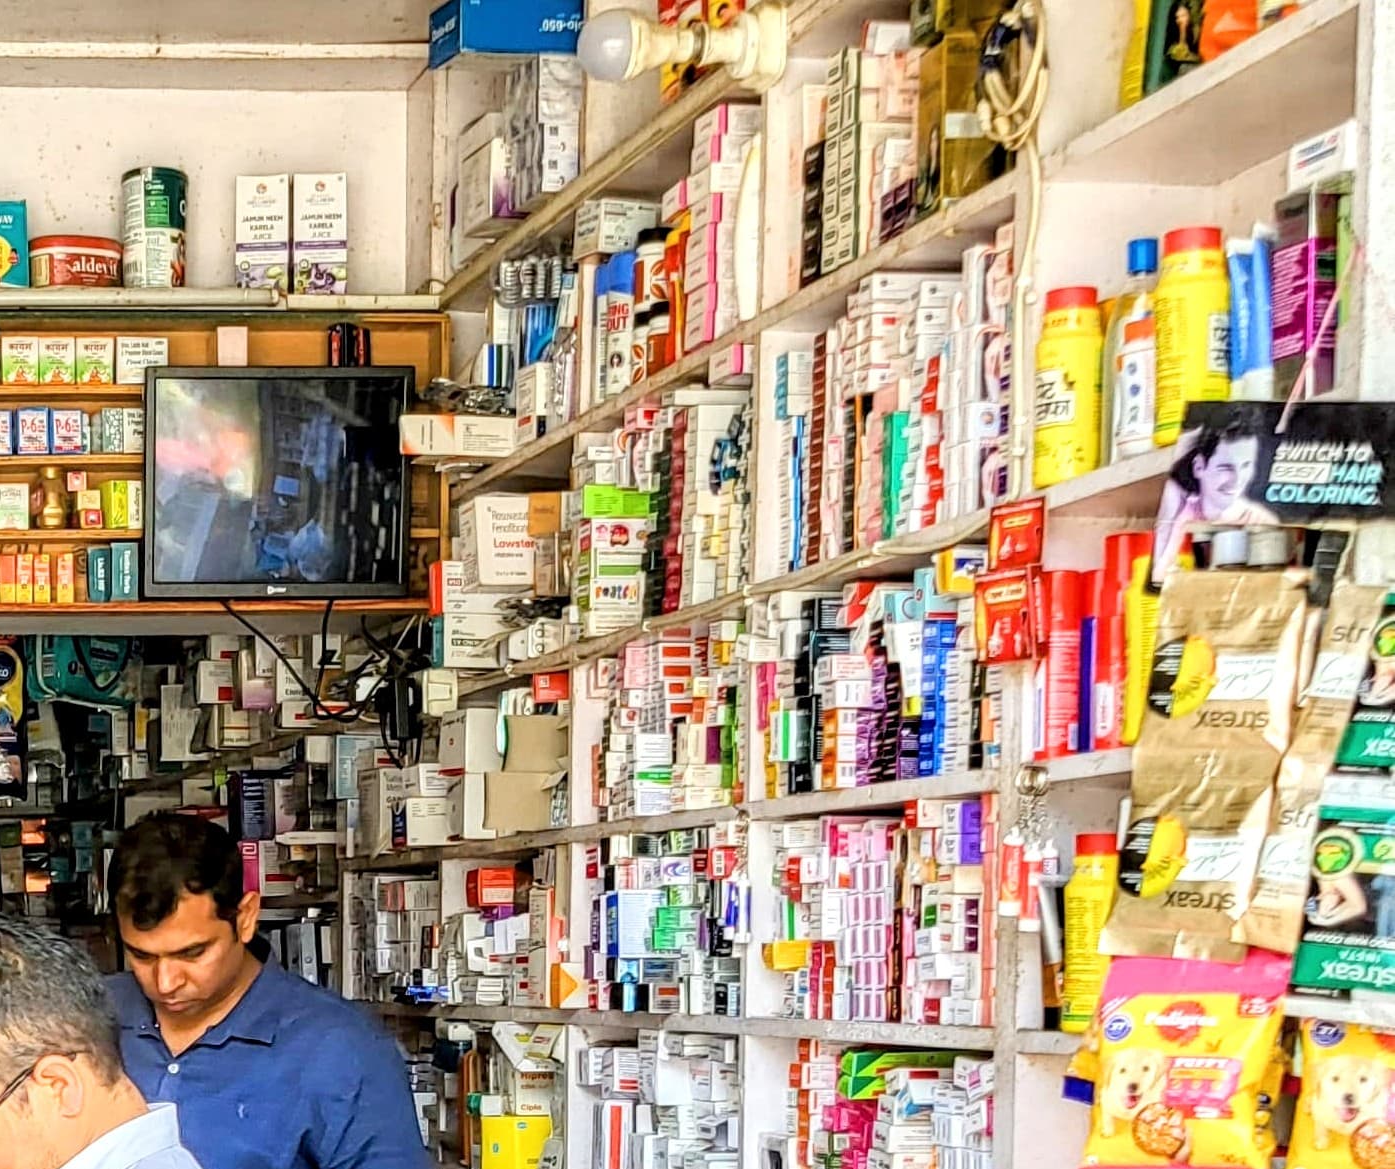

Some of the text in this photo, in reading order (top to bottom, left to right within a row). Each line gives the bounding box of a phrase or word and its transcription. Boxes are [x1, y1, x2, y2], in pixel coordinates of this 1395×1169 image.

[1273, 442, 1372, 462] SWITCH TO
[1329, 464, 1383, 484] HAIR
[1194, 708, 1269, 732] streax
[1162, 889, 1236, 913] streax
